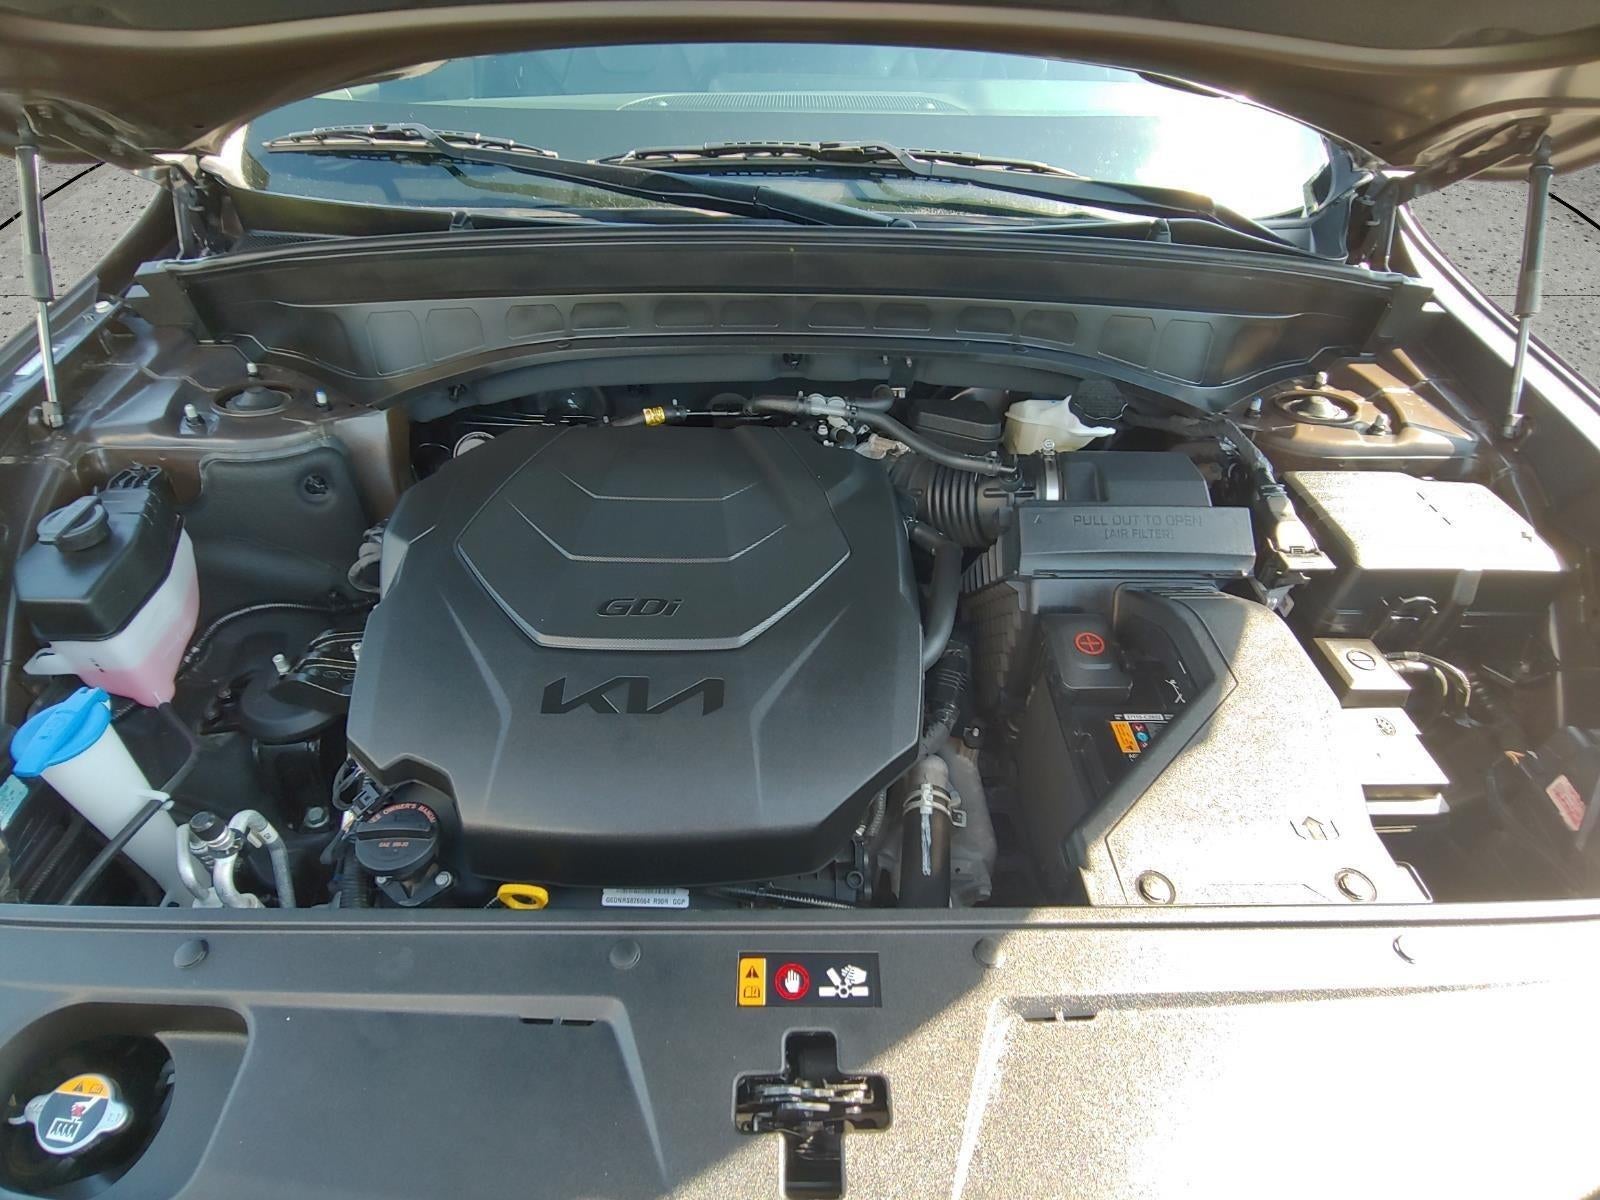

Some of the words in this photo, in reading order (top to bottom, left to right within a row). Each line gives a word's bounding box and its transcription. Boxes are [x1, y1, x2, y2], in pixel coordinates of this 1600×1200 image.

[1072, 514, 1108, 526] PULL
[1112, 514, 1139, 526] OUT
[1142, 514, 1162, 526] TO
[1165, 514, 1203, 527] OPEN
[597, 599, 684, 617] GDi
[540, 675, 725, 716] KIA
[382, 802, 417, 815] OWNER'S
